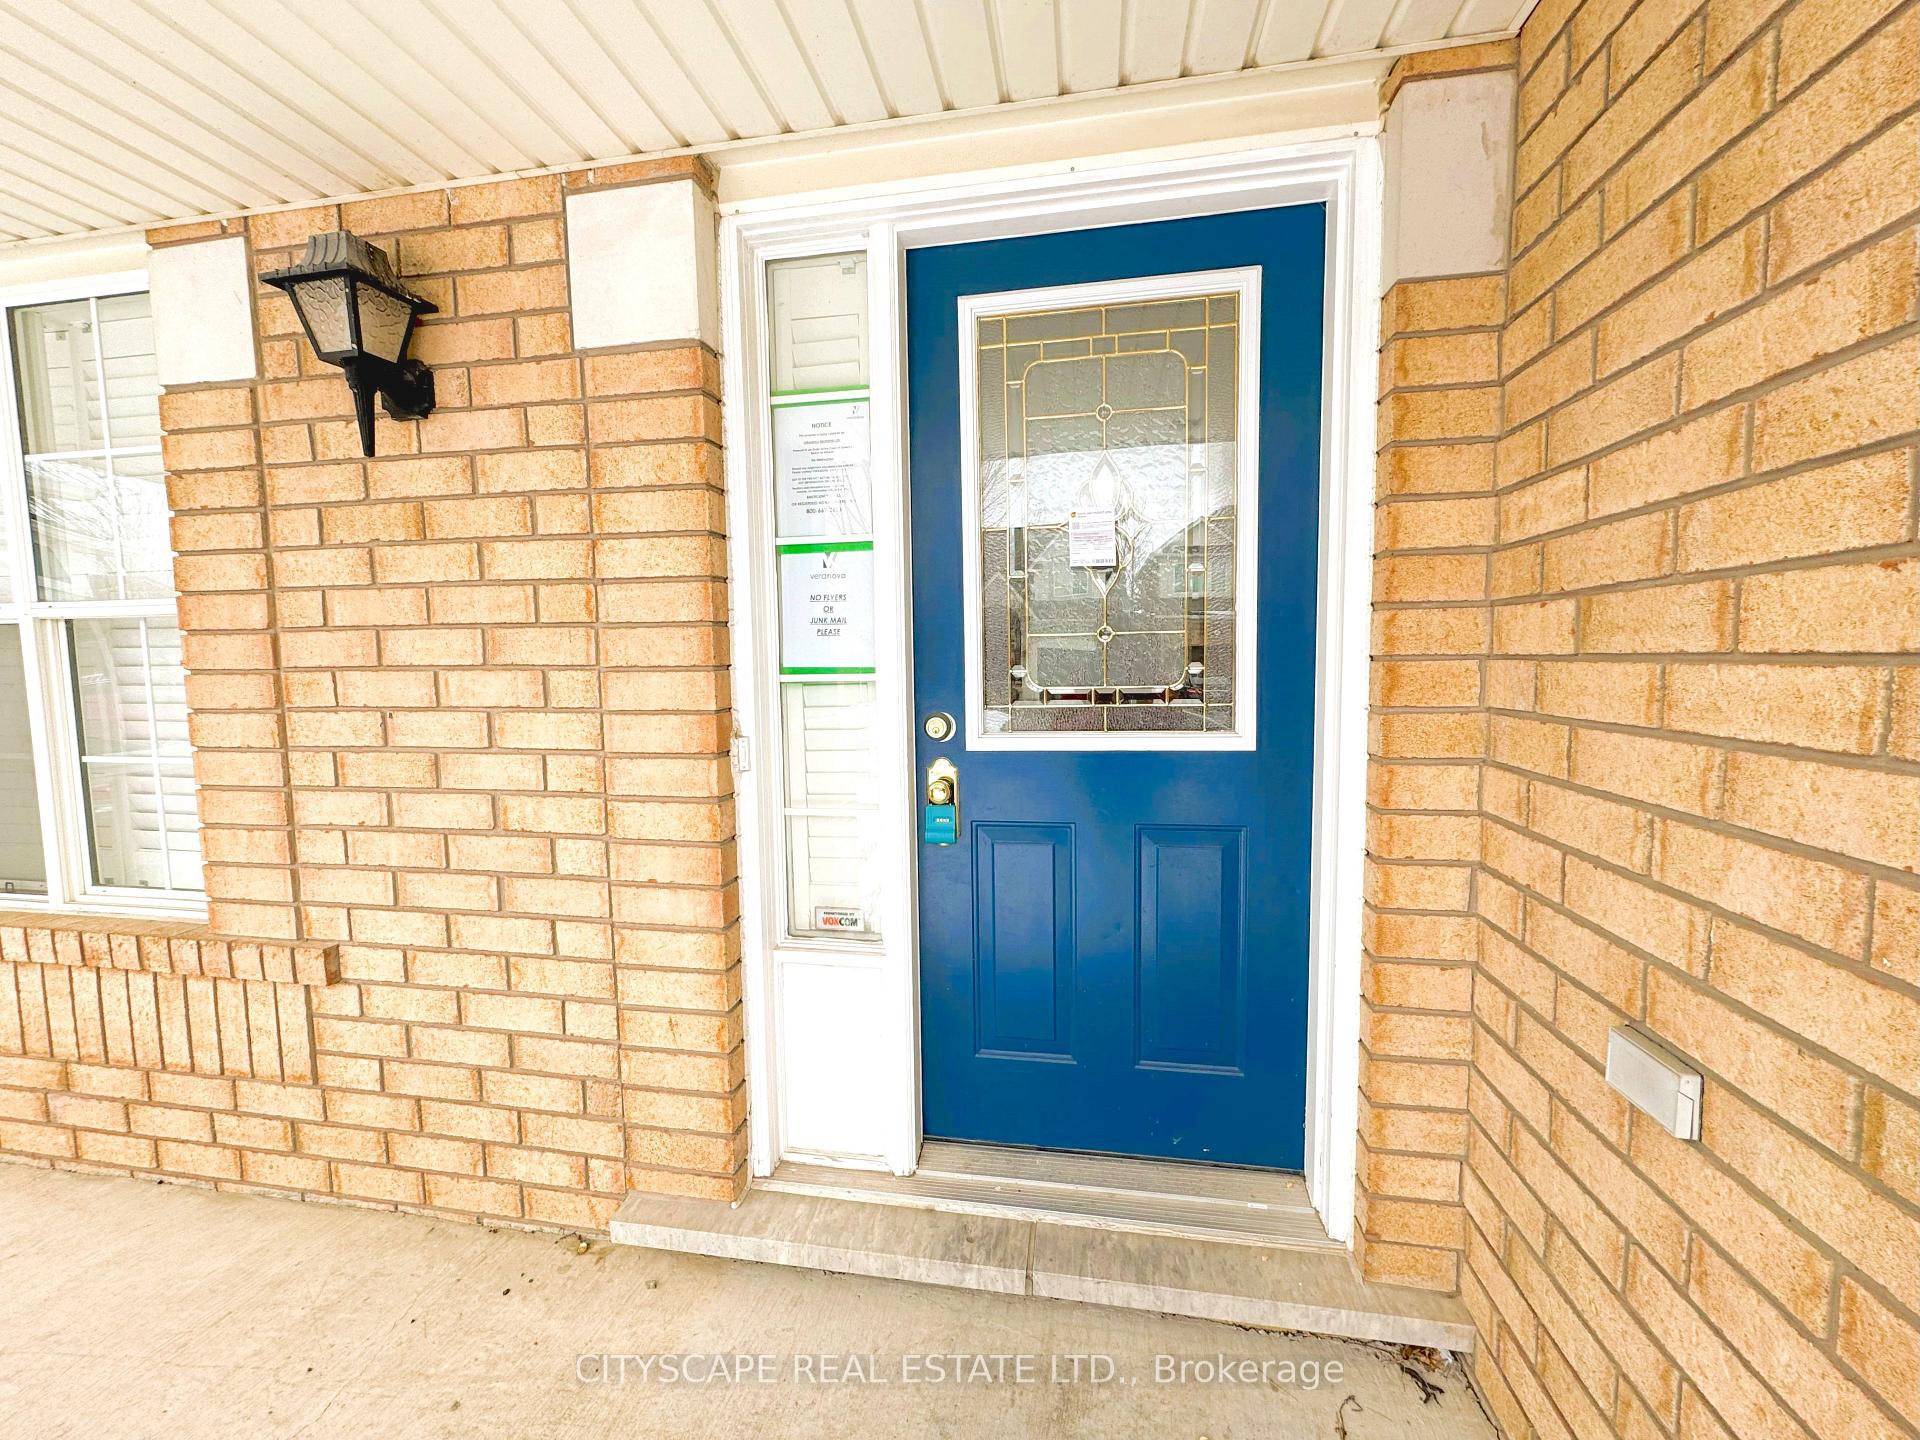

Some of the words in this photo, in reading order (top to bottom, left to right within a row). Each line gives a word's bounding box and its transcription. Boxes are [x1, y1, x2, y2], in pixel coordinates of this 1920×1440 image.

[811, 421, 832, 429] NOTICE
[823, 593, 847, 601] FLYERS
[823, 605, 834, 613] OR
[829, 616, 847, 624] MAIL
[816, 628, 841, 636] PLEASE
[822, 916, 858, 927] VOXCOM
